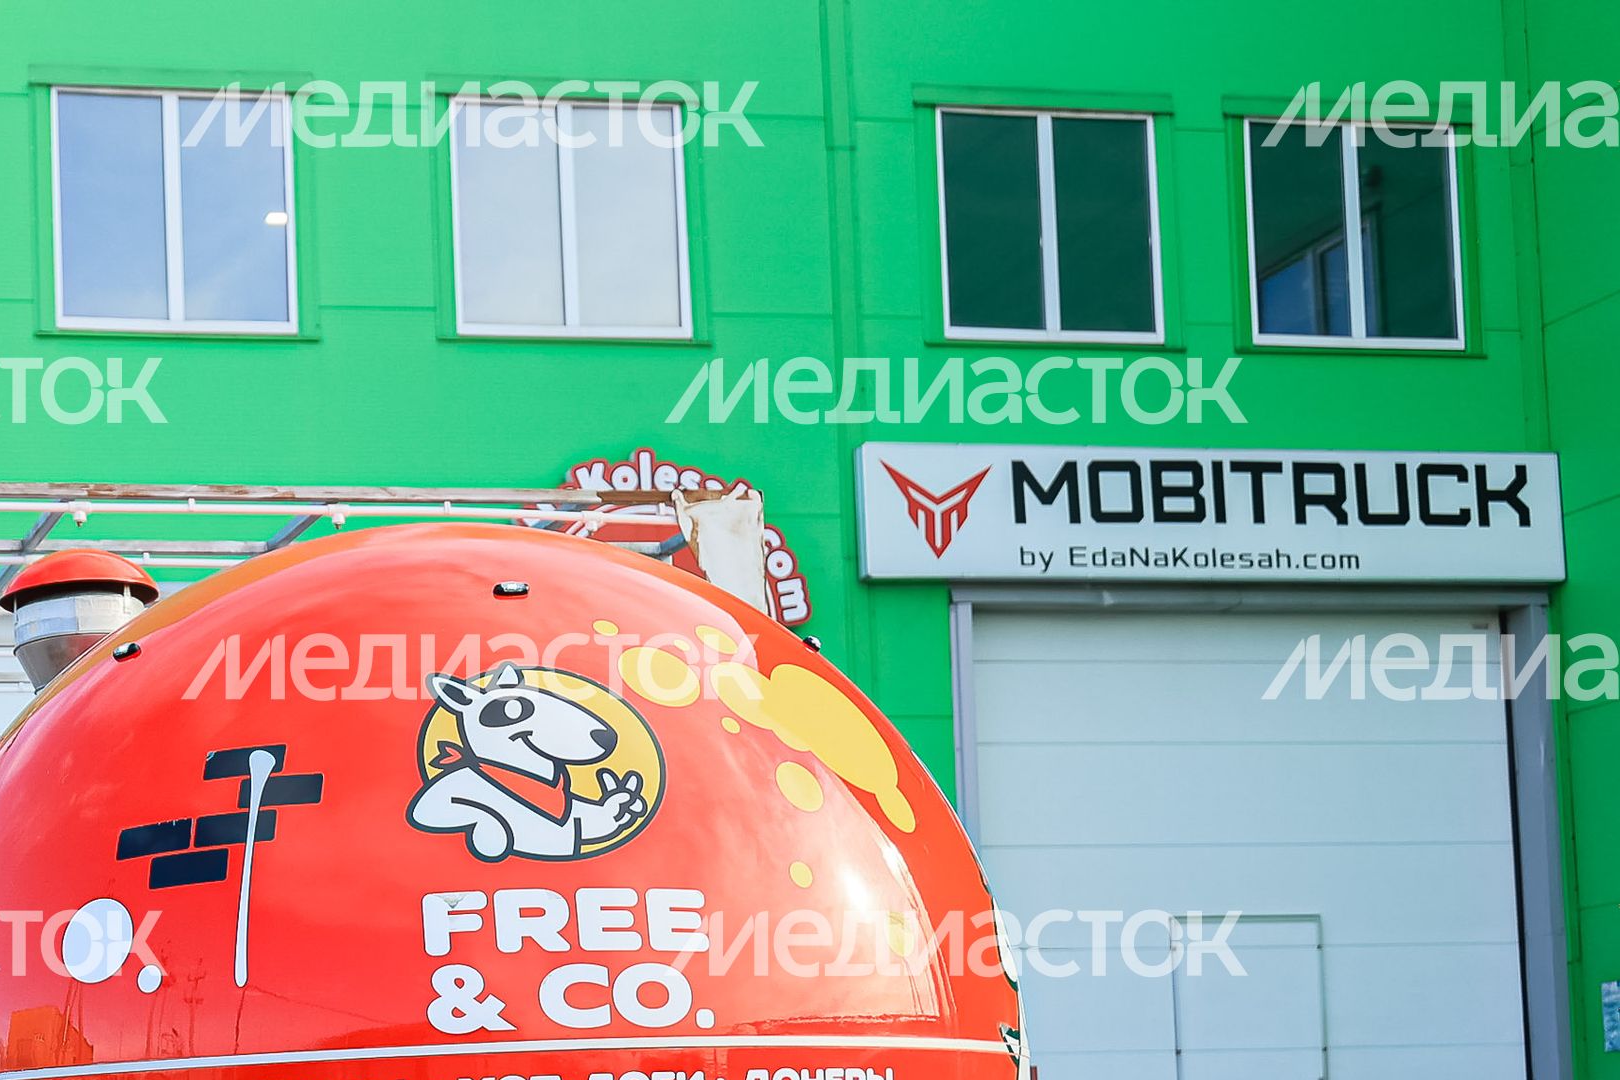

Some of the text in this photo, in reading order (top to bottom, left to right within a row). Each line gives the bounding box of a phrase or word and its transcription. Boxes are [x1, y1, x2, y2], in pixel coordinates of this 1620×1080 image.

[1011, 459, 1532, 528] MOBITRUCK
[1019, 546, 1360, 573] by EdaNaKolesah.com
[421, 887, 710, 957] FREE
[426, 962, 716, 1035] & CO.
